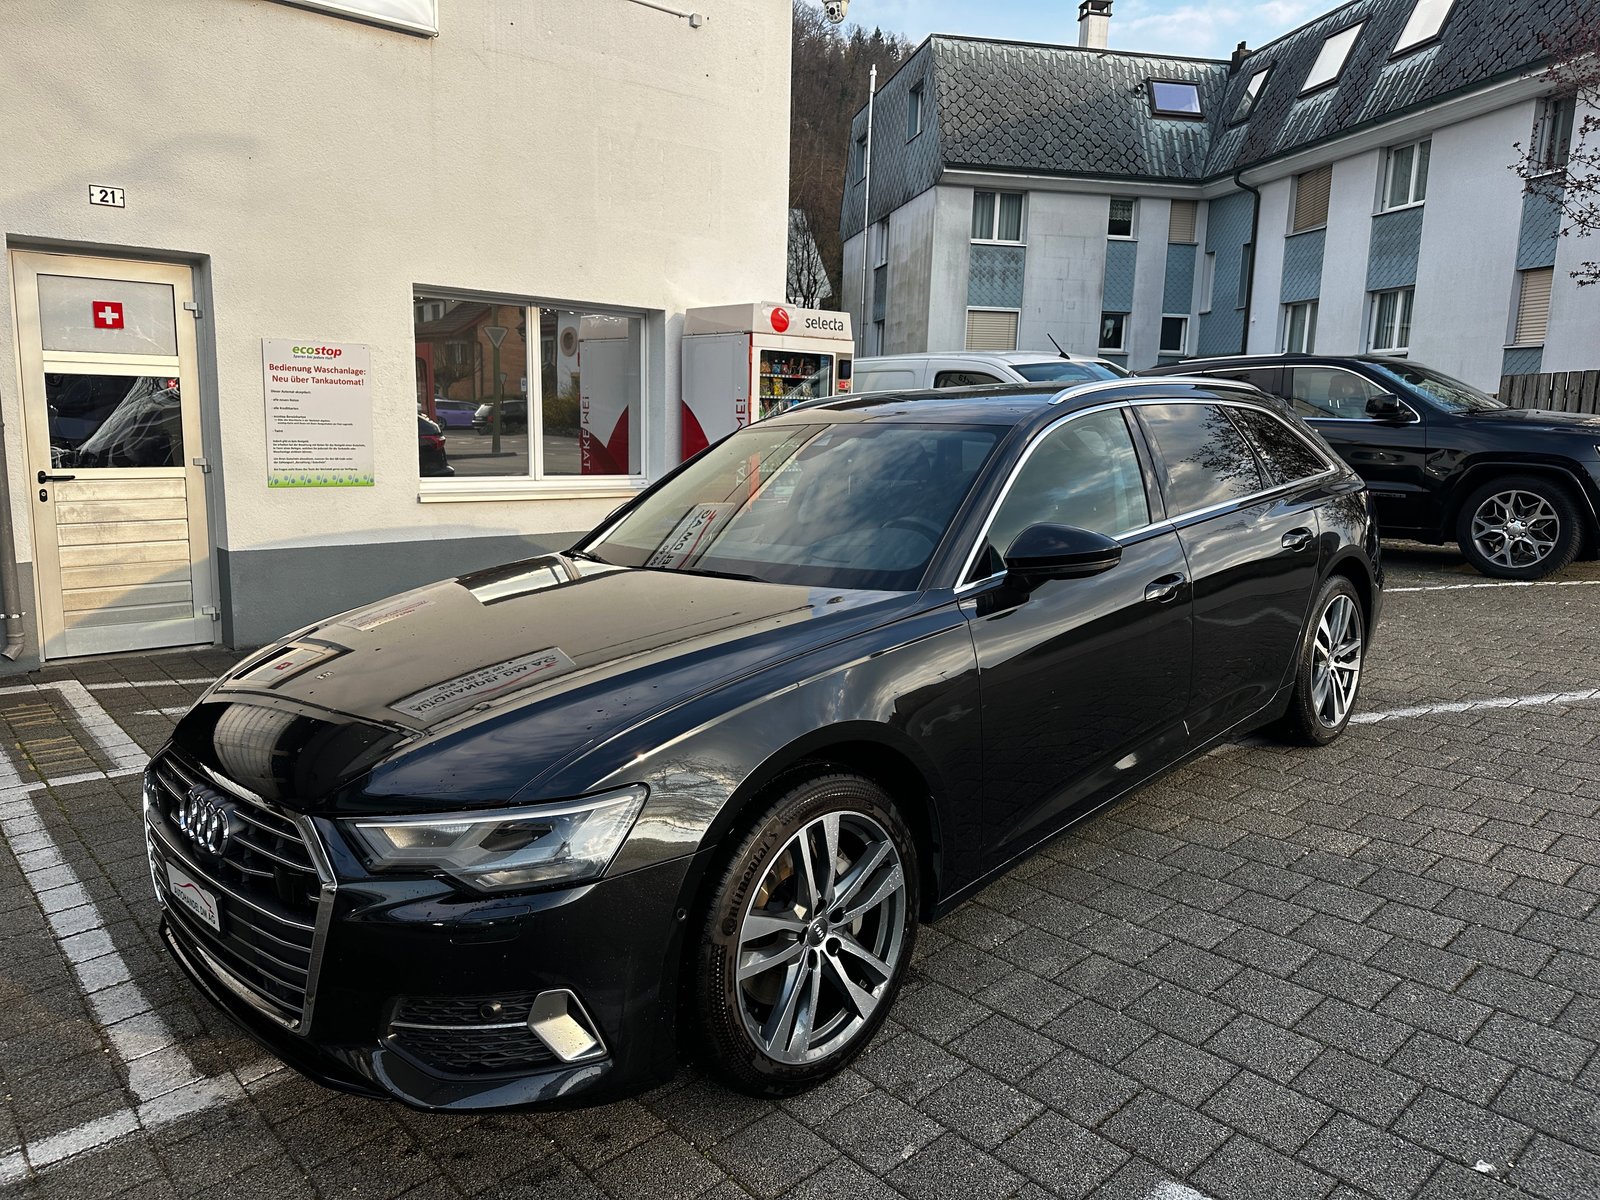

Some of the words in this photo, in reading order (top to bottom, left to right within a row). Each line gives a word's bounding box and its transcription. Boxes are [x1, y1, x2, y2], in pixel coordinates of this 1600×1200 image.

[99, 189, 116, 204] 21
[805, 316, 844, 331] selecta
[292, 346, 342, 358] ecostop
[269, 363, 312, 374] Bedienung
[313, 365, 366, 377] Waschanlage:
[272, 375, 289, 383] Neu
[291, 375, 309, 384] über
[311, 376, 364, 386] Tankautomat!
[736, 399, 746, 430] ME!
